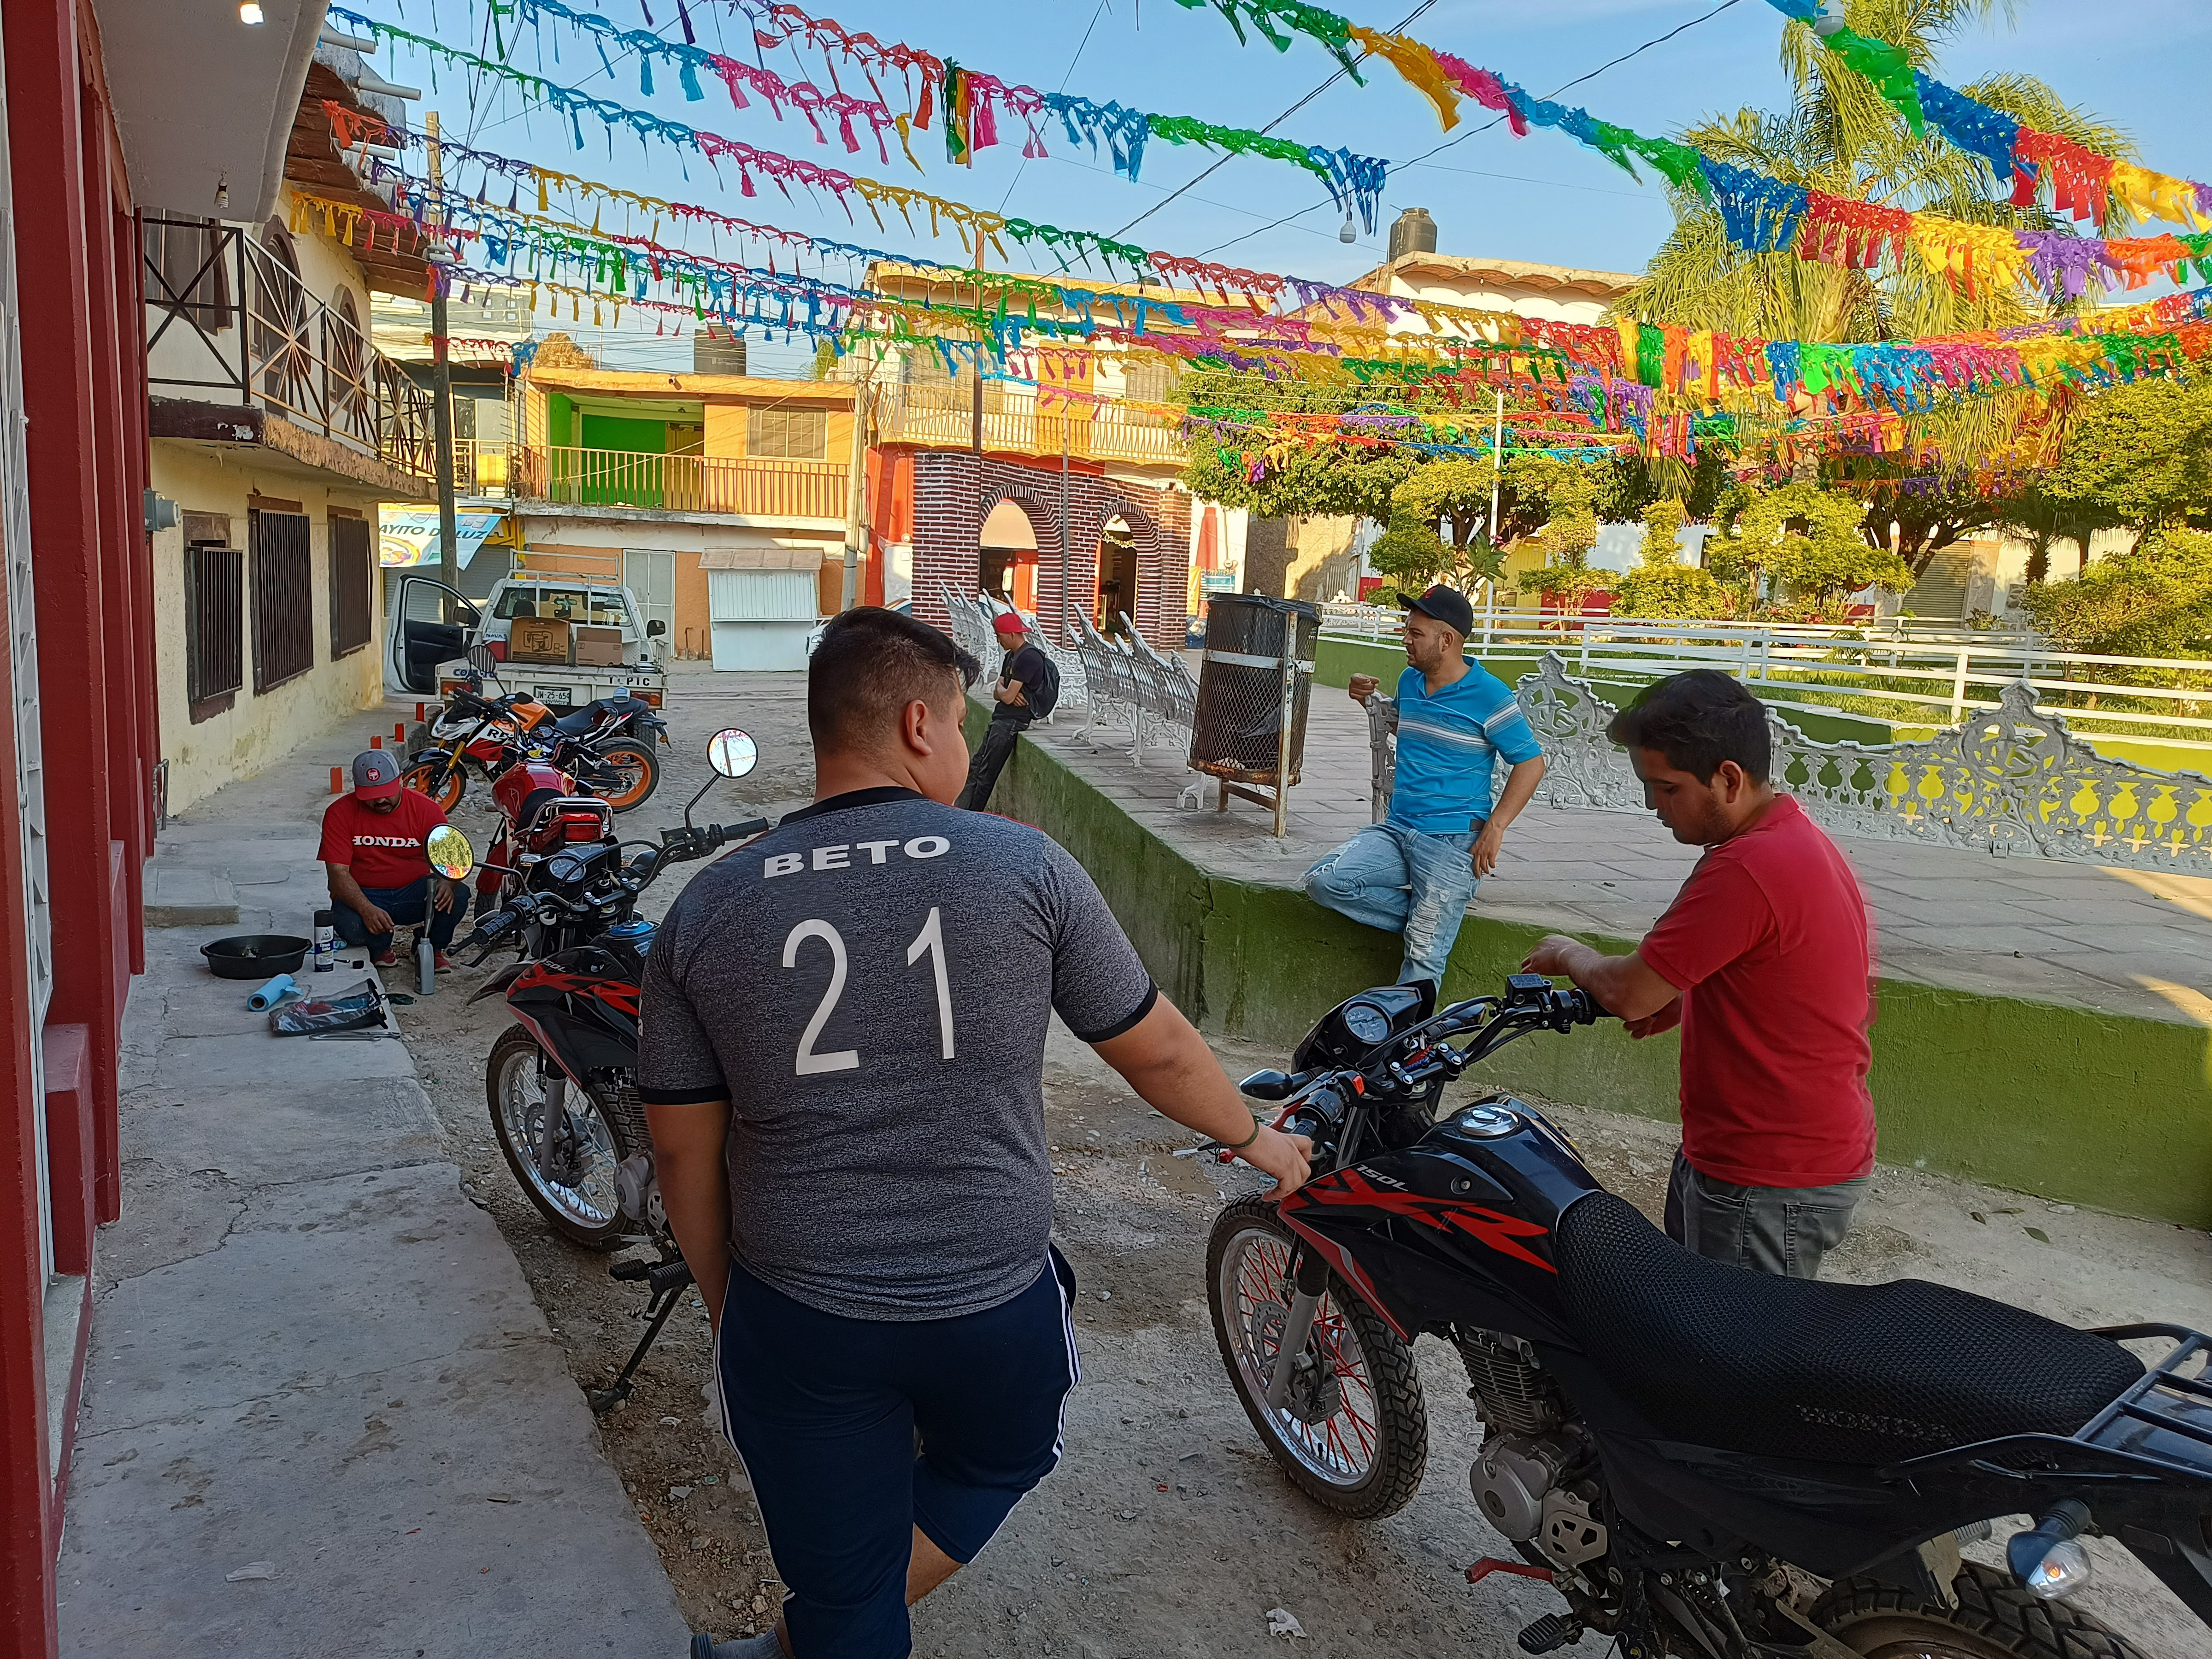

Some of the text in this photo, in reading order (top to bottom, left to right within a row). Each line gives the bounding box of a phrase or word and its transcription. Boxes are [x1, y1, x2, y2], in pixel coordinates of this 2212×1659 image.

[457, 530, 488, 539] LUZ
[352, 835, 421, 847] HONDA
[764, 835, 950, 879] BETO
[782, 906, 955, 1076] 21
[1356, 1164, 1409, 1191] 150L
